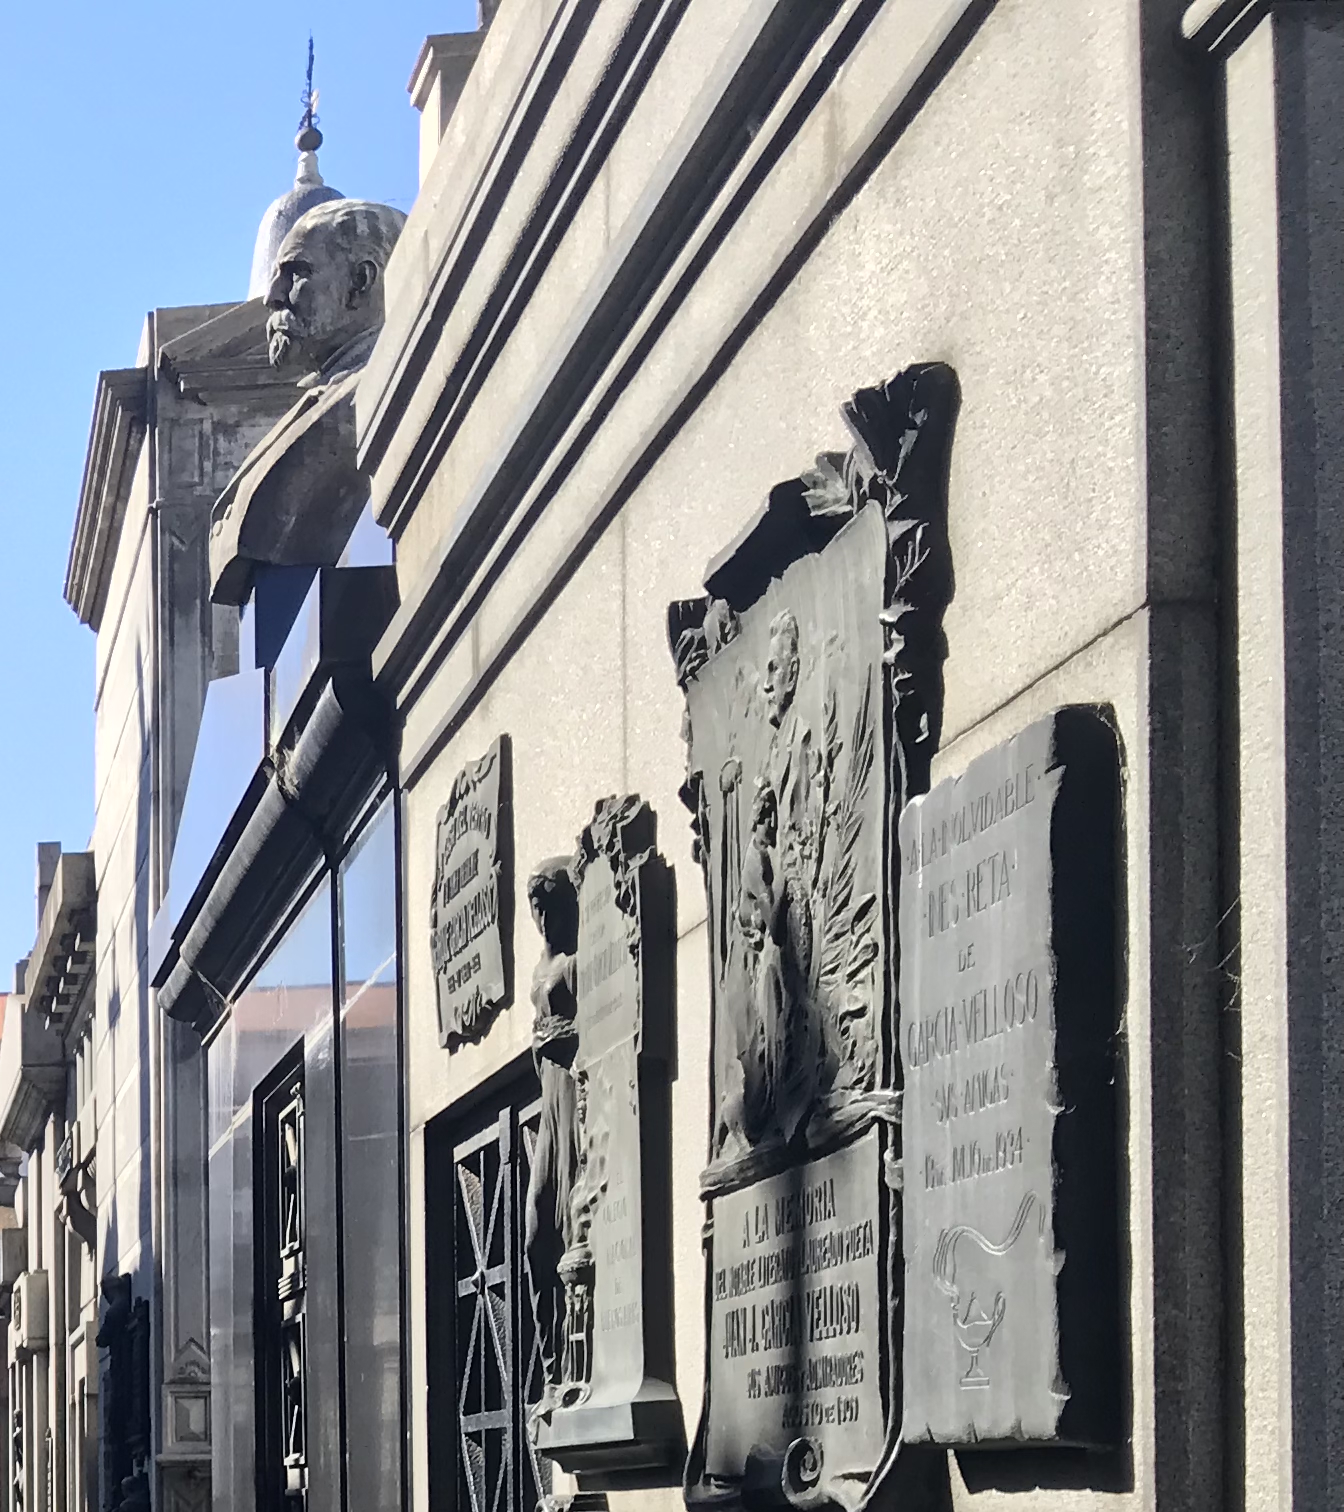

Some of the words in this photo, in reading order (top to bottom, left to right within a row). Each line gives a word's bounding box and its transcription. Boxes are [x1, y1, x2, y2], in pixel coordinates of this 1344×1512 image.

[941, 761, 1035, 856] INOLVIDABLE
[927, 872, 960, 939] INES
[965, 845, 1011, 920] RETA
[957, 941, 976, 975] DE
[906, 1002, 958, 1071] GARCIA
[961, 966, 1038, 1046] VELLOSO
[963, 1061, 1009, 1115] AMIGAS
[741, 1209, 750, 1249] A
[754, 1201, 769, 1244] LA
[774, 1175, 836, 1238] MEMORIA
[804, 1277, 860, 1344] VELLOSO
